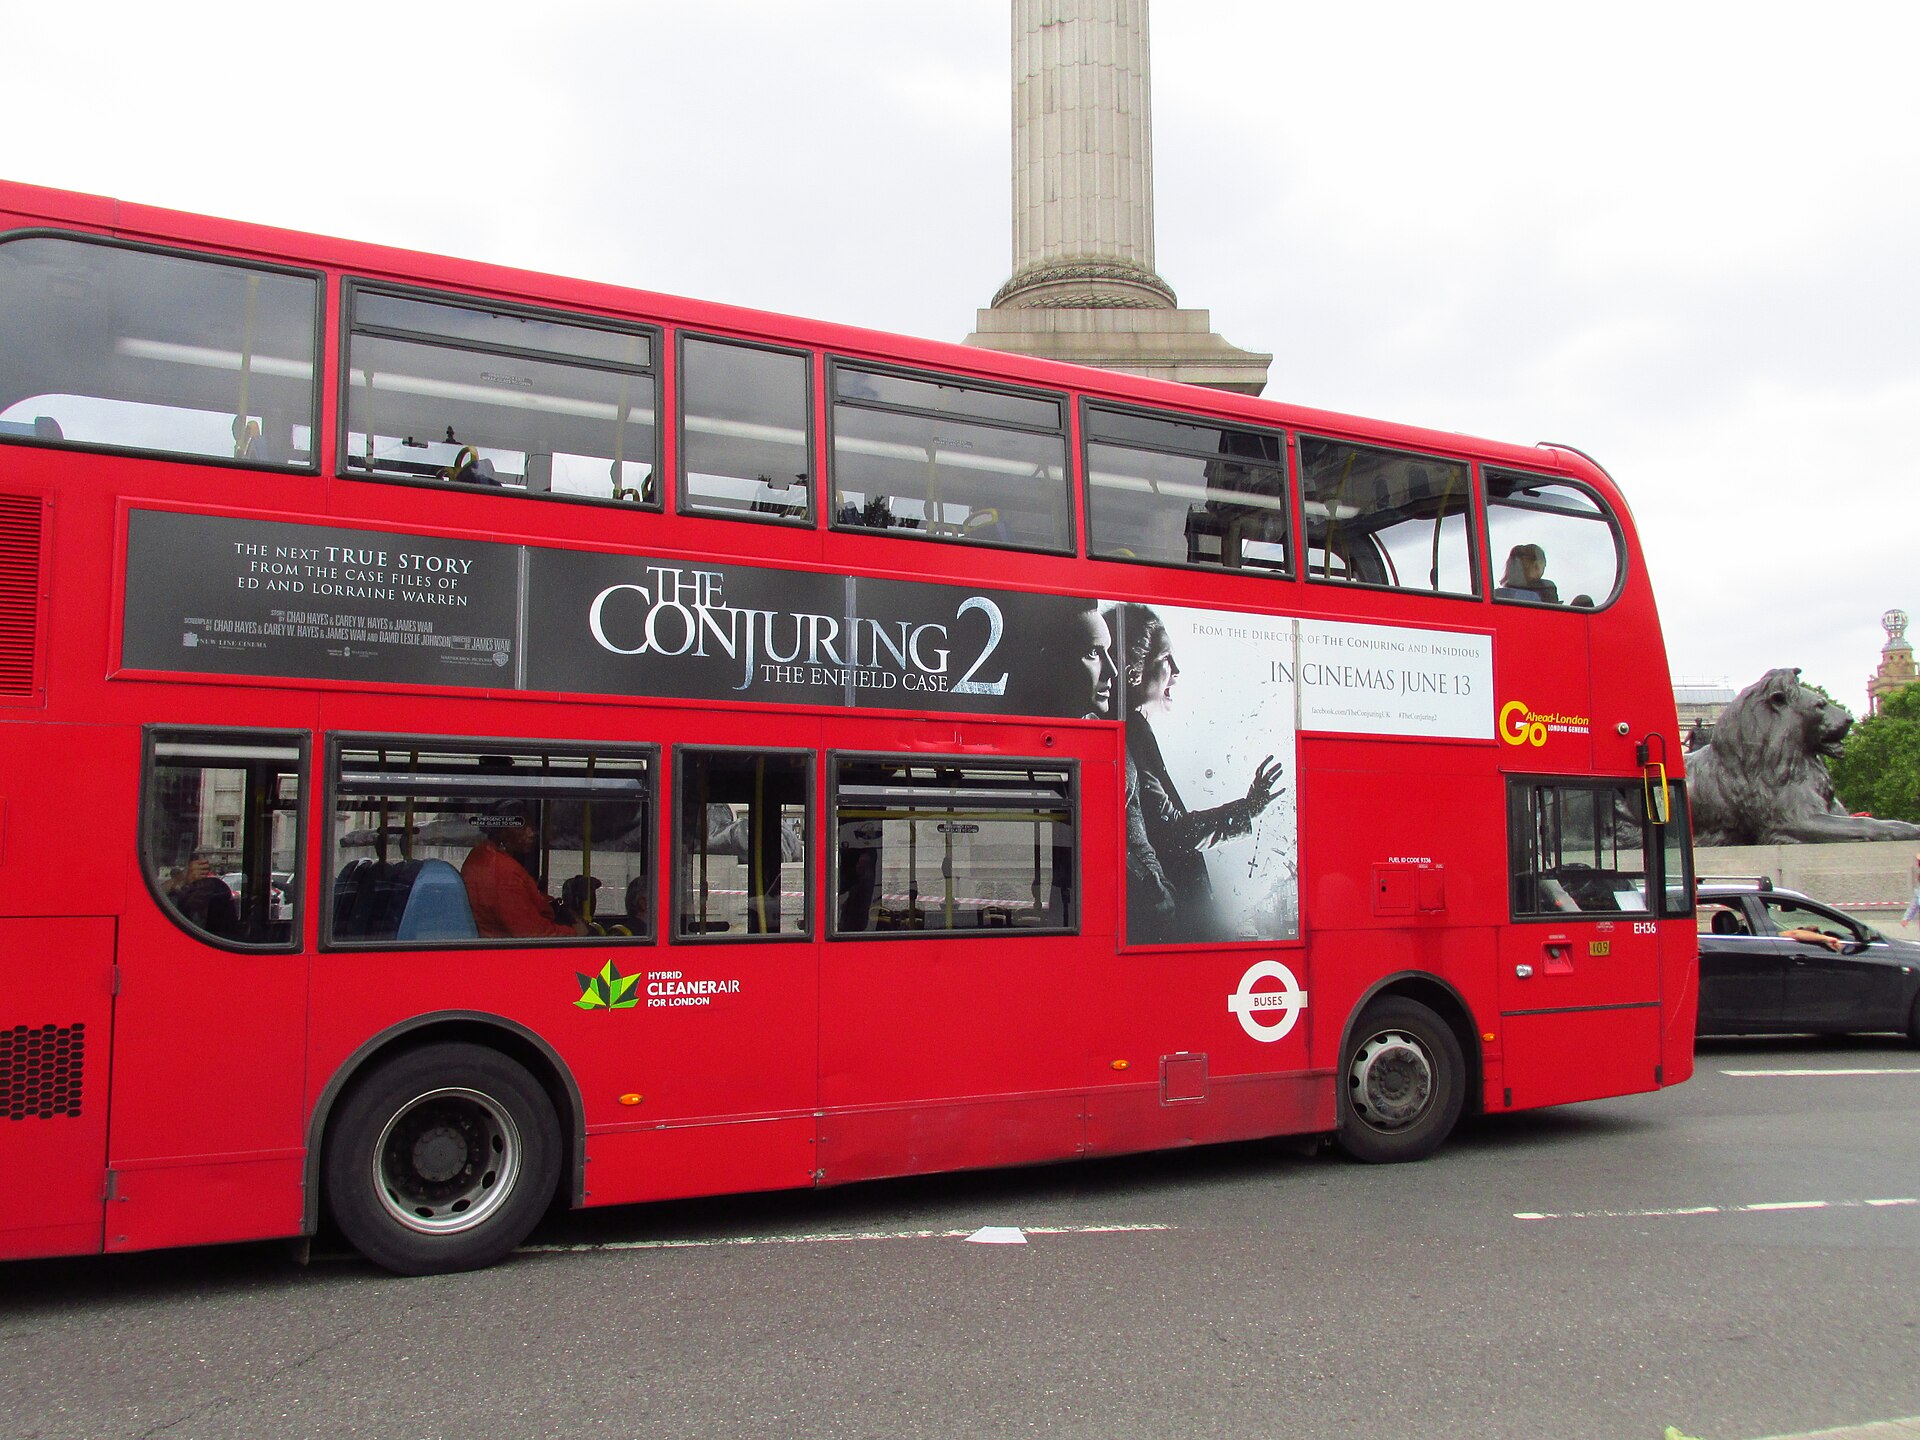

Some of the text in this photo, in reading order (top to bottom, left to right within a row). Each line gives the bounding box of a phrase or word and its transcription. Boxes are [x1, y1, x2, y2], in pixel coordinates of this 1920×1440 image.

[234, 543, 473, 574] THE NEXT TRUE STORY
[251, 561, 458, 589] FROM THE CASE FILES OF
[646, 565, 727, 609] THE
[238, 577, 467, 607] ED AND LORRAINE WARREN
[213, 620, 233, 633] CHAD
[234, 621, 257, 635] HAYES
[263, 622, 285, 637] CAREY
[297, 625, 319, 639] HAYES
[325, 627, 349, 641] JAMES
[350, 628, 367, 642] WAN
[400, 632, 420, 646] LESLIE
[420, 634, 451, 648] JOHNSON
[286, 611, 305, 624] CHAD
[307, 612, 329, 626] HAYES
[335, 614, 357, 628] CAREY
[367, 617, 388, 632] HAYES
[394, 620, 416, 634] JAMES
[416, 621, 433, 634] WAN
[219, 639, 237, 647] LINE
[238, 640, 267, 649] CINEMA
[588, 583, 1009, 696] CONJURING 2
[1192, 623, 1480, 659] FROM THE DIRECTOR OF THE CONJURING AND INSIDIOUS
[760, 664, 949, 693] THE ENFIELD CASE
[1271, 661, 1471, 697] IN CINEMAS JUNE 13
[1499, 700, 1547, 747] Go
[1525, 711, 1589, 726] Ahead-London
[1547, 724, 1590, 735] LONDON GENERAL
[1633, 922, 1657, 935] EH36
[1592, 941, 1609, 955] 109
[648, 971, 682, 980] HYBRID
[647, 997, 710, 1008] FOR LONDON
[1253, 995, 1283, 1007] BUSES
